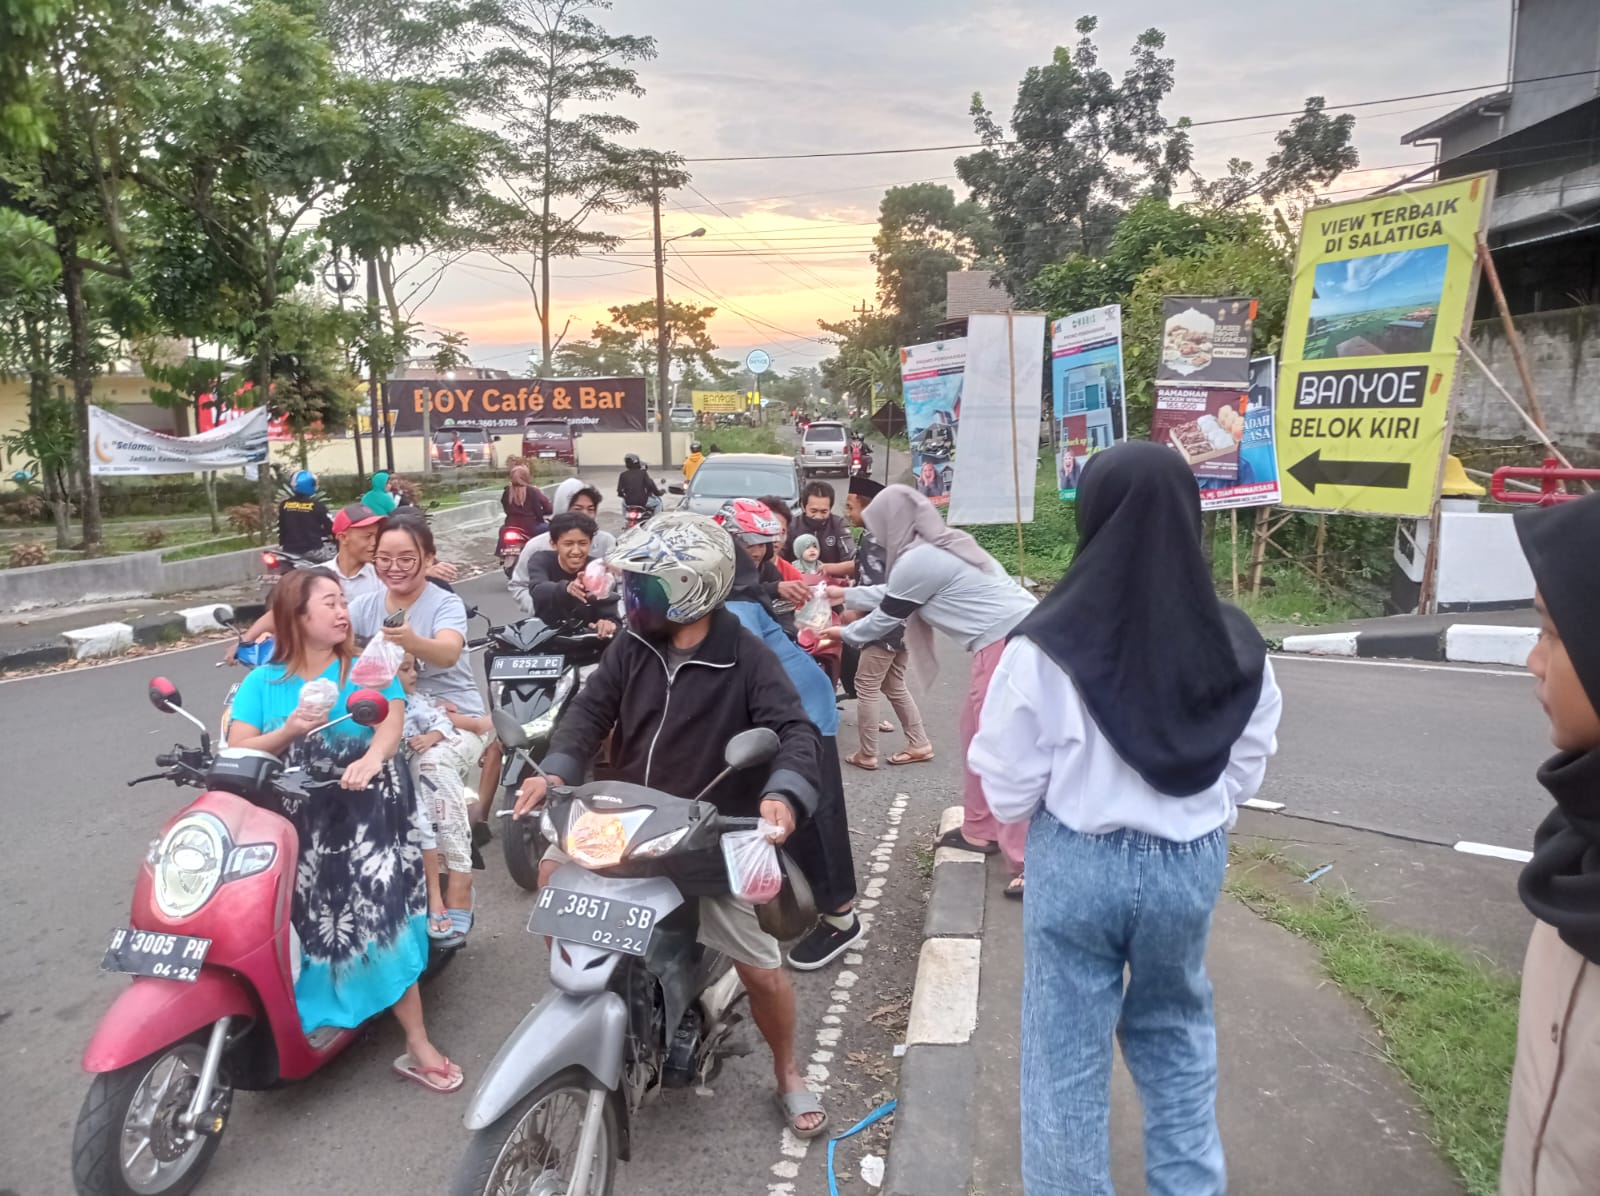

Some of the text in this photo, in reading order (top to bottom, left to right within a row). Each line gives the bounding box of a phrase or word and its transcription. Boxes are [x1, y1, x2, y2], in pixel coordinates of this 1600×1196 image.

[1321, 197, 1460, 236] VIEW TERBAIK
[1325, 220, 1443, 253] DI SALATIGA
[414, 385, 625, 413] BOY Café & Bar
[1158, 389, 1208, 398] RAMADHAN
[1299, 371, 1421, 405] BANYOE
[1244, 415, 1270, 430] ADAH
[1290, 417, 1420, 439] BELOK KIRI
[538, 889, 652, 929] H 3851 SB
[110, 929, 209, 960] H 3005 PH
